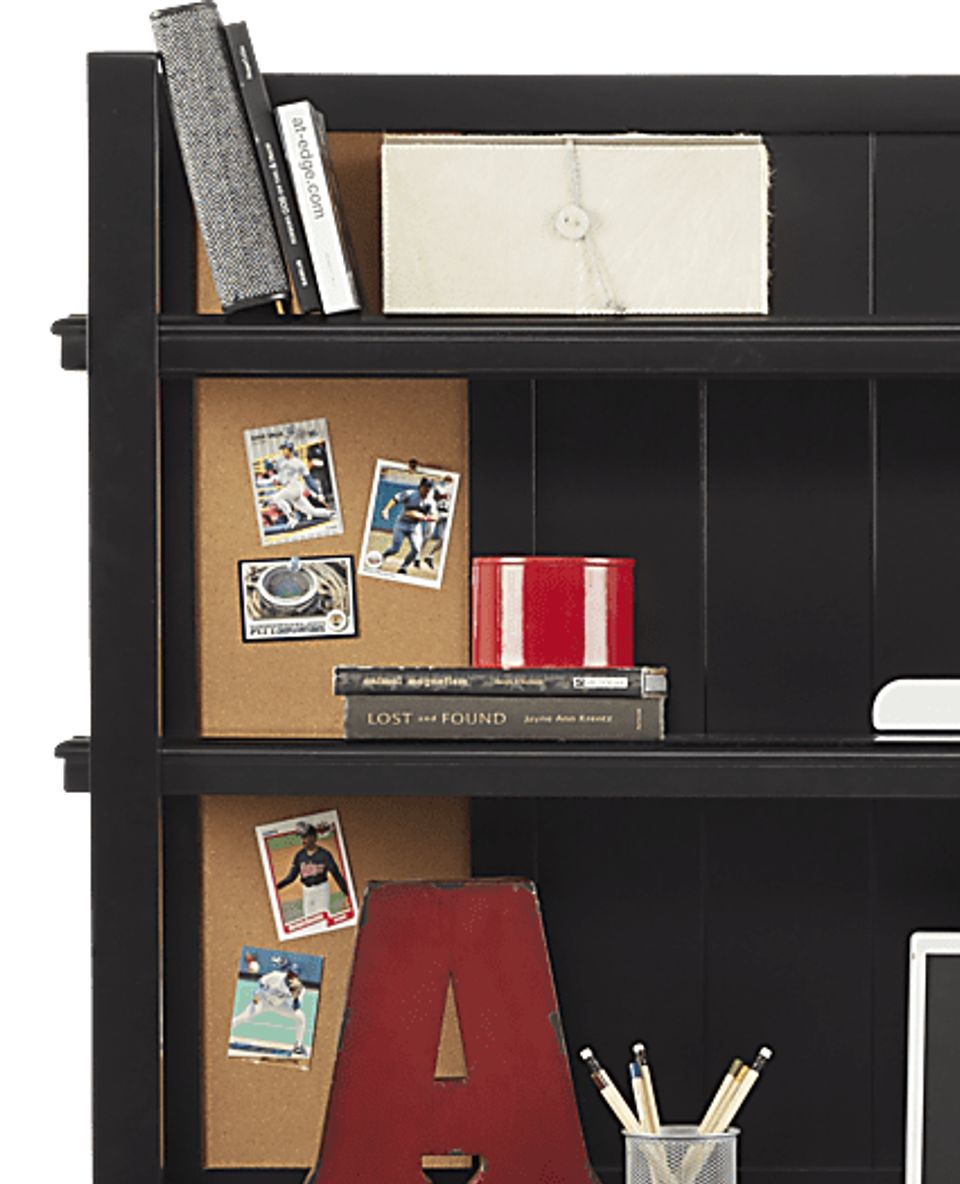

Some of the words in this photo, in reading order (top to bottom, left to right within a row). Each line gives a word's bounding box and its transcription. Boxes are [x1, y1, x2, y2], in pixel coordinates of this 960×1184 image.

[292, 117, 325, 220] at-edge.com
[367, 712, 412, 725] LOST
[441, 712, 507, 725] FOUND
